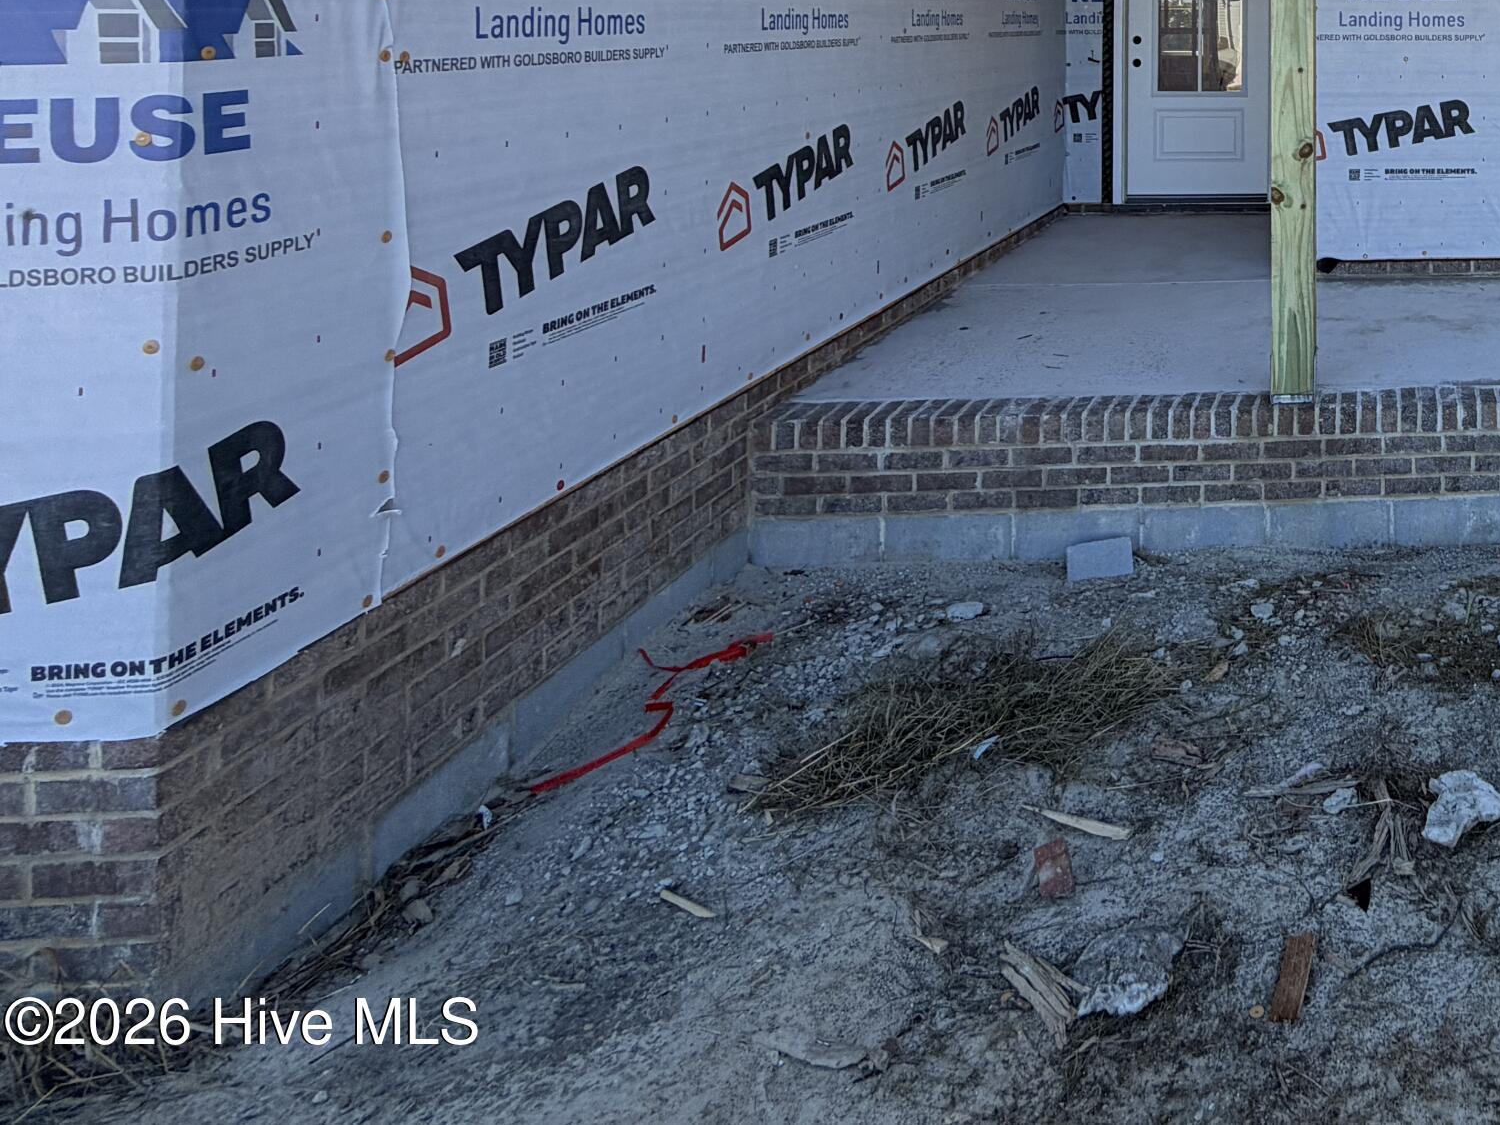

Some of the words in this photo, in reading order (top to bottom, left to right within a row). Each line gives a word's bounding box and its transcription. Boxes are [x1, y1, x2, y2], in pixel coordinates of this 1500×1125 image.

[475, 5, 570, 45] Landing
[577, 6, 646, 36] Homes
[761, 7, 809, 35] Landing
[812, 7, 849, 30] Homes
[911, 8, 940, 30] Landing
[941, 9, 963, 26] Homes
[1339, 11, 1403, 31] Landing
[1408, 11, 1465, 28] Homes
[1342, 34, 1362, 42] WITH
[1363, 34, 1413, 42] GOLDSBORO
[1414, 34, 1453, 42] BUILDERS
[394, 56, 477, 75] PARTNERED
[480, 53, 510, 70] WITH
[513, 50, 583, 68] GOLDSBORO
[584, 47, 631, 64] BUILDERS
[724, 42, 763, 54] PARTNERED
[763, 41, 779, 52] WITH
[905, 100, 966, 172] TYPAR
[999, 86, 1040, 143] TYPAR
[1326, 99, 1476, 156] TYPAR
[752, 124, 854, 221] TYPAR
[102, 191, 272, 244] Homes
[454, 165, 657, 316] TYPAR
[123, 249, 241, 284] BUILDERS
[542, 313, 575, 335] BRING
[575, 307, 591, 322] ON
[591, 300, 609, 317] THE
[610, 284, 657, 310] ELEMENTS.
[31, 662, 106, 682] BRING
[110, 660, 146, 677] ON
[149, 641, 197, 675] THE
[200, 586, 305, 652] ELEMENTS.
